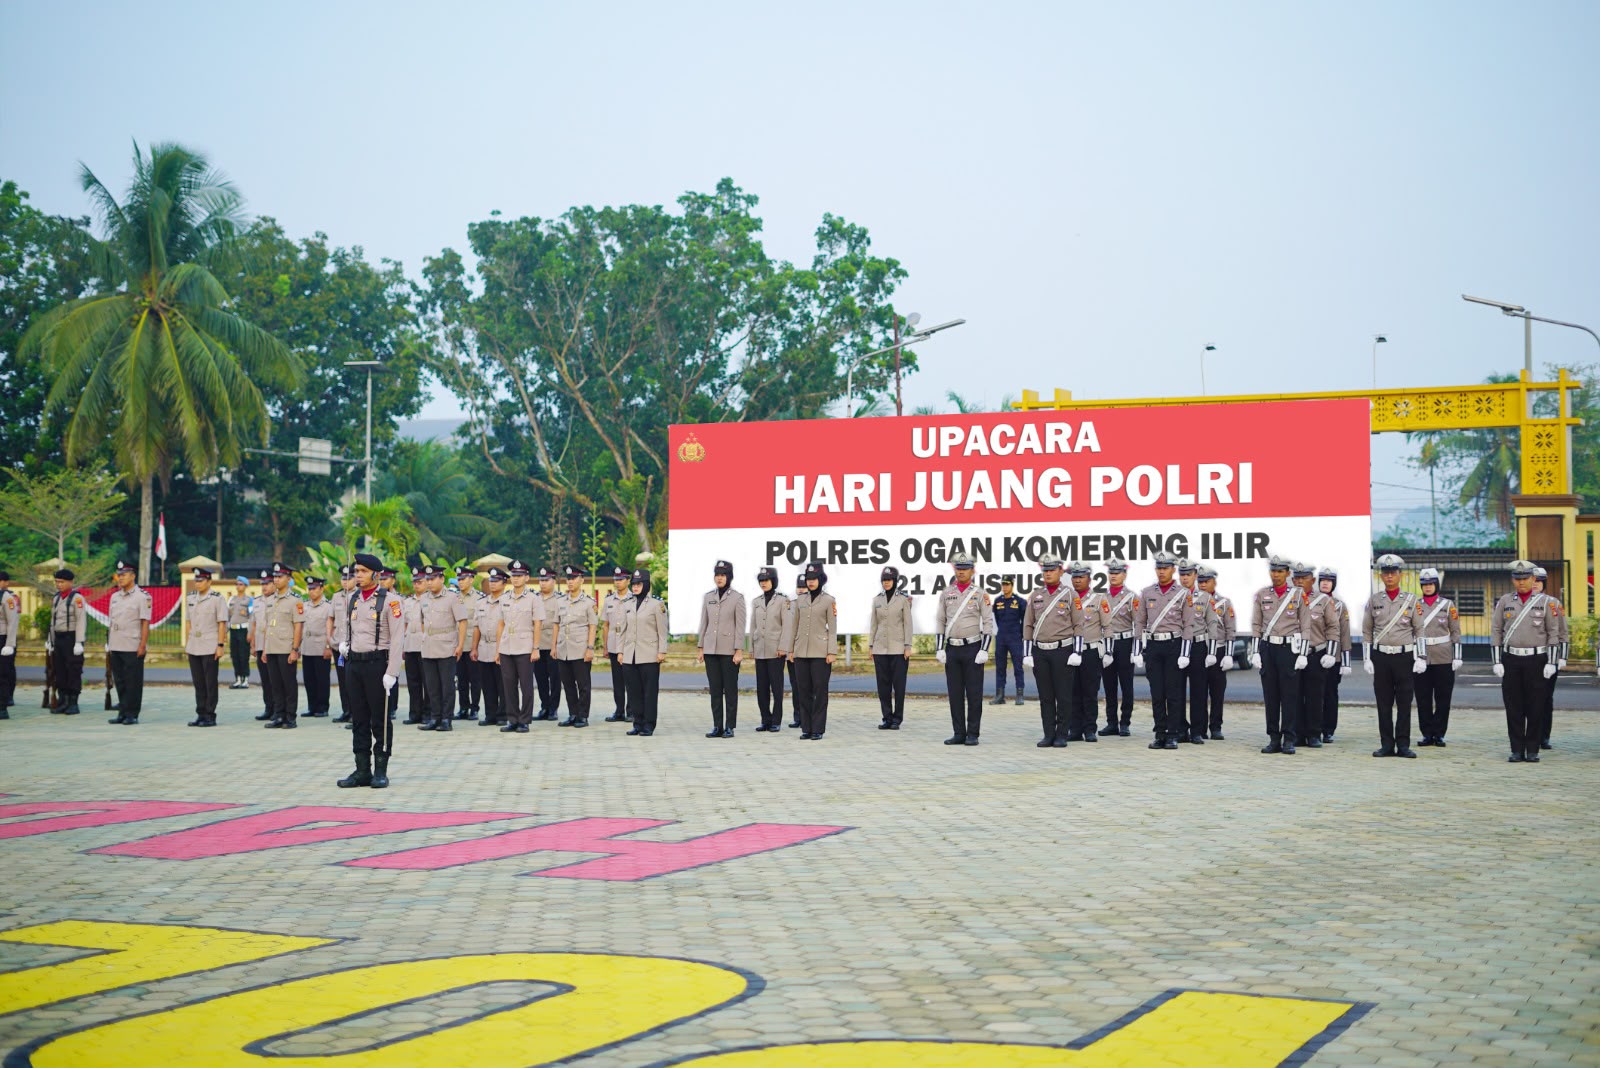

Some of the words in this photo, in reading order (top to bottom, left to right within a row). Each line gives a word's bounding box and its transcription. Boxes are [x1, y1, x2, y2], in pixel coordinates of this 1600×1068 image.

[912, 421, 1102, 459] UPACARA
[774, 472, 892, 514] HARI
[906, 467, 1074, 512] JUANG
[1090, 461, 1253, 507] POLRI
[766, 539, 891, 566] POLRES
[899, 537, 992, 565] OGAN
[1003, 533, 1189, 563] KOMERING
[1201, 532, 1271, 560] ILIR
[898, 574, 925, 596] 21
[931, 573, 1046, 597] ASUS
